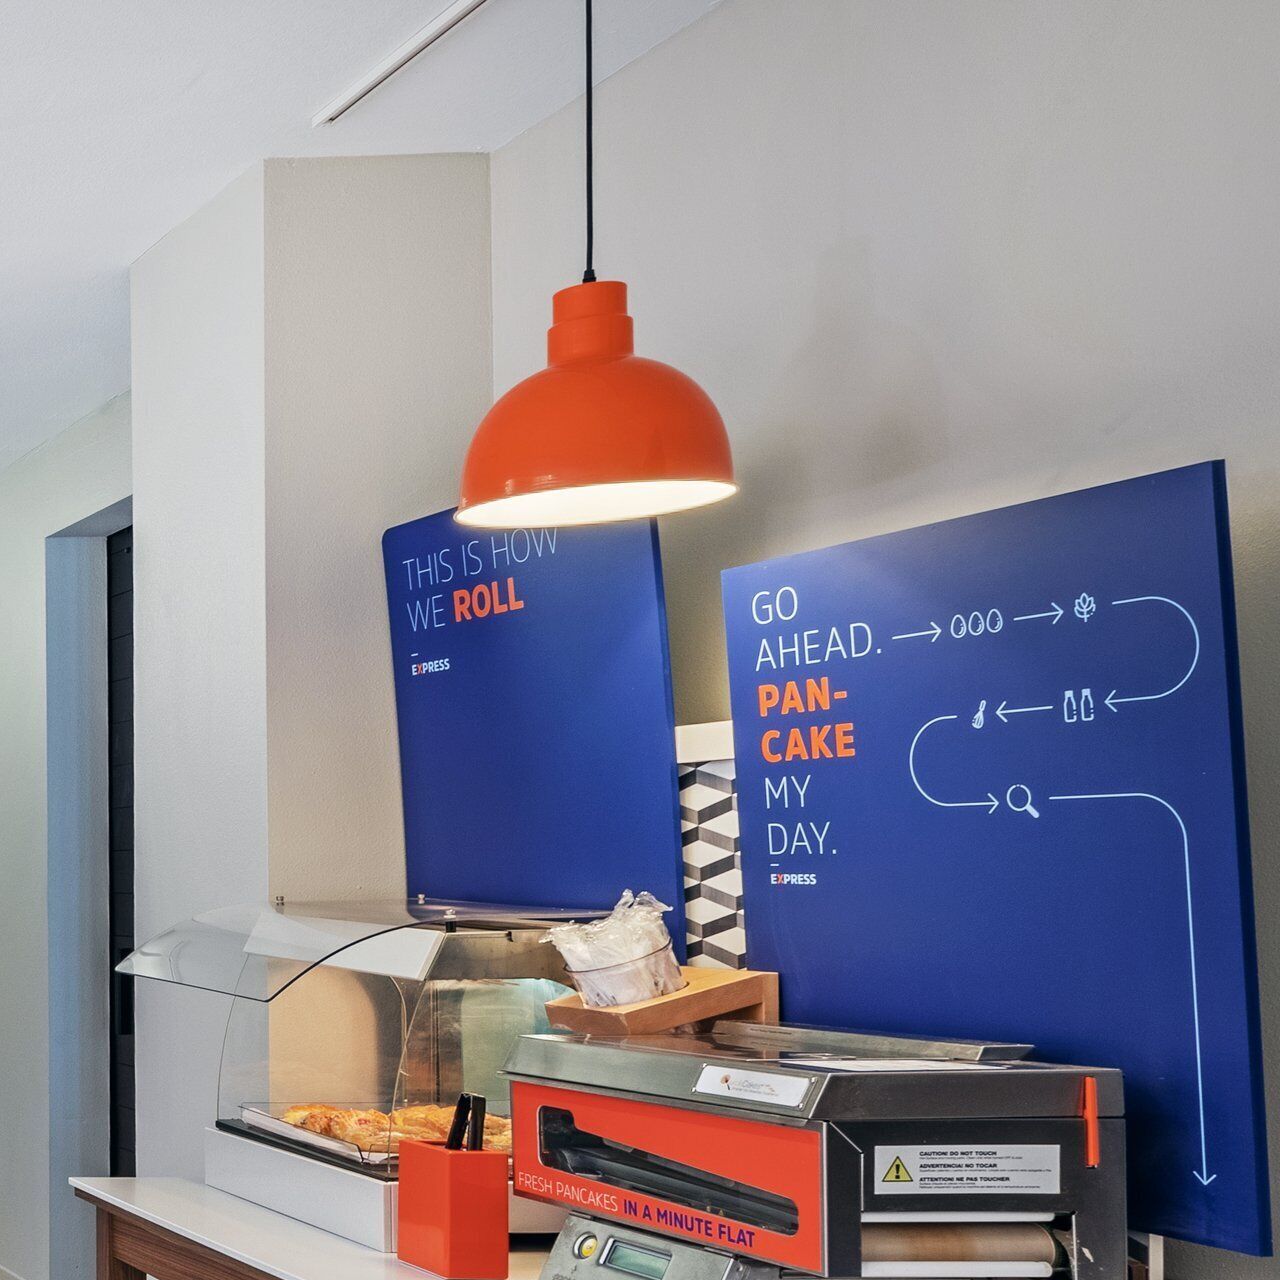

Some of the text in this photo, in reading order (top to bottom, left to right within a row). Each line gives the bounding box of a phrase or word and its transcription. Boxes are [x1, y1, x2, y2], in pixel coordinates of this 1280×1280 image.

[402, 526, 559, 591] THIS IS HOW
[406, 577, 525, 632] WE ROLL
[751, 586, 799, 625] GO
[411, 658, 451, 676] EXPRESS
[755, 622, 883, 672] AHEAD.
[758, 676, 848, 717] PAN-
[760, 723, 856, 763] CAKE
[764, 774, 812, 809] MY
[767, 821, 838, 856] DAY.
[770, 873, 817, 886] EXPRESS
[518, 1171, 756, 1248] FRESH PANCAKES IN A MINUTE FLAT
